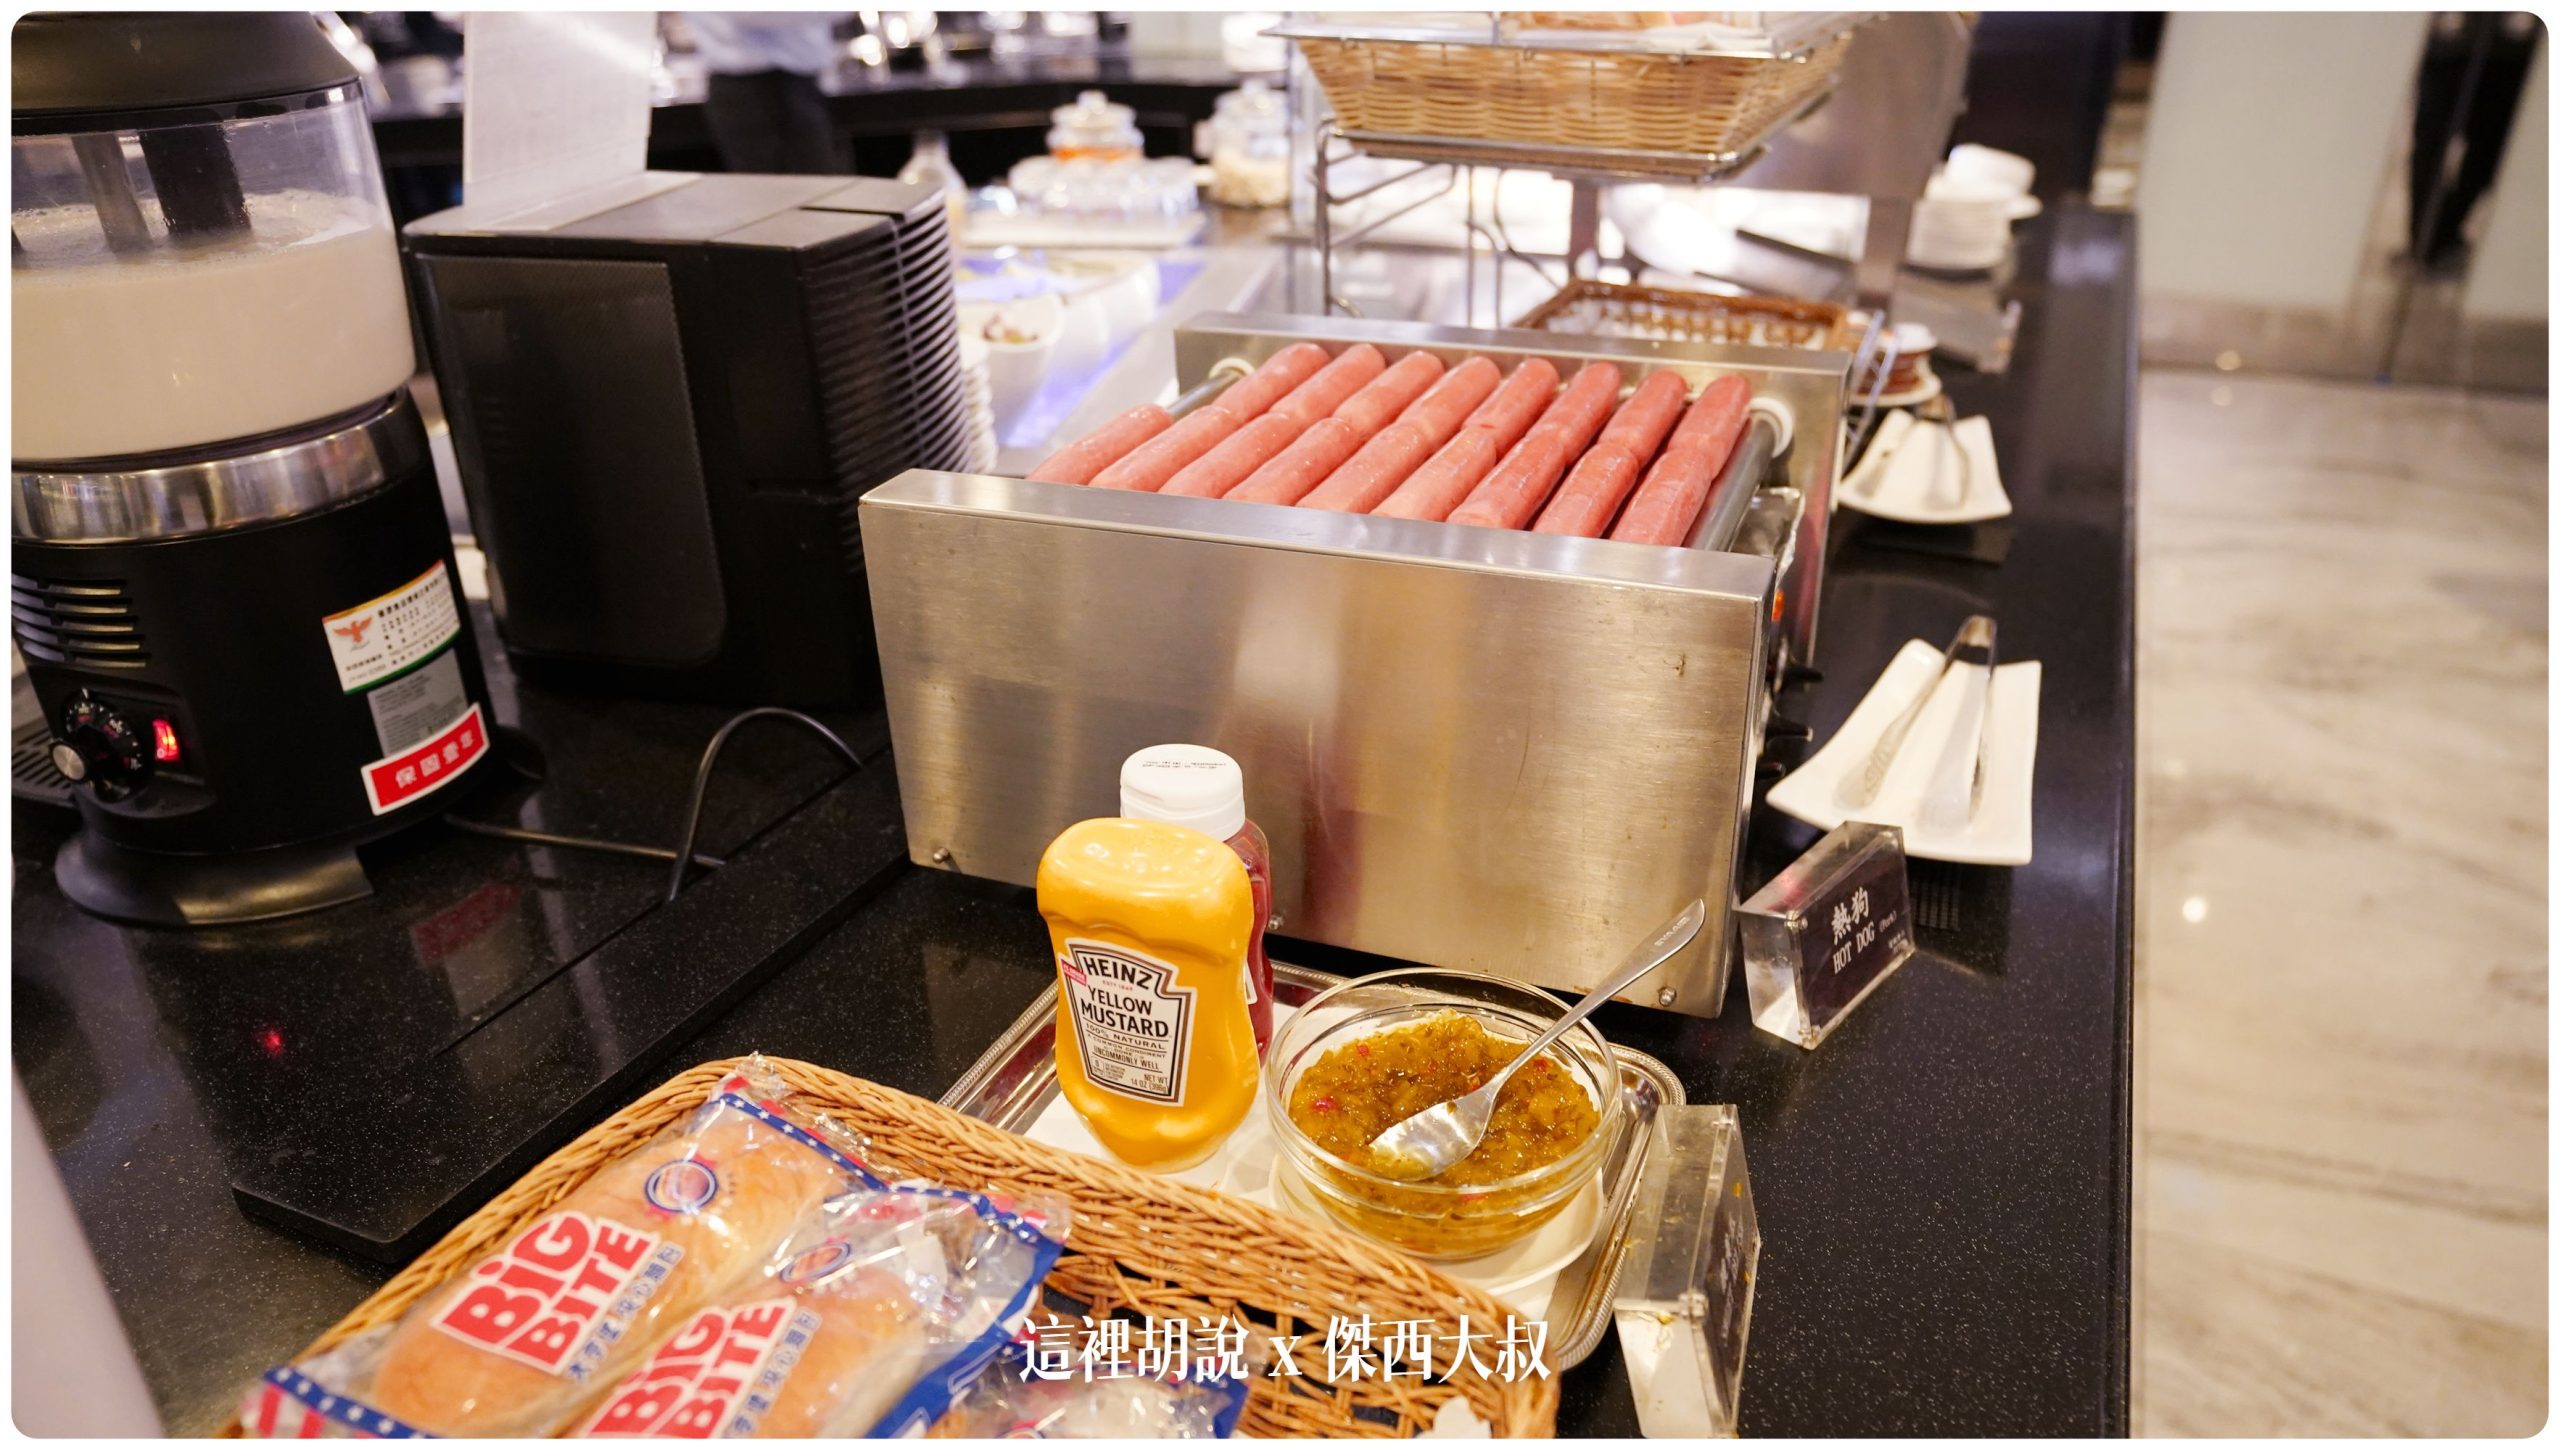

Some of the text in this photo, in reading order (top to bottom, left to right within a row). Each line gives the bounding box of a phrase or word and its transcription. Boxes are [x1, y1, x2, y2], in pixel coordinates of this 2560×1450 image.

[395, 729, 474, 789] 保固壹年
[1831, 886, 1870, 946] 熱狗
[1832, 941, 1852, 975] HOT
[1856, 921, 1875, 954] DOG
[1082, 956, 1153, 990] HEINZ
[1087, 985, 1152, 1015] YELLOW
[1080, 998, 1169, 1038] MUSTARD
[1086, 1023, 1165, 1050] 100% NATURAL
[1093, 1036, 1123, 1050] COMMON
[1125, 1047, 1166, 1059] CONDIMENT
[1094, 1045, 1160, 1070] UNCOMMONLY WELL
[1130, 1077, 1138, 1086] 14
[1139, 1079, 1148, 1088] OZ
[1144, 1073, 1157, 1082] NET
[506, 1225, 651, 1366] BITE
[655, 1306, 787, 1438] BITE
